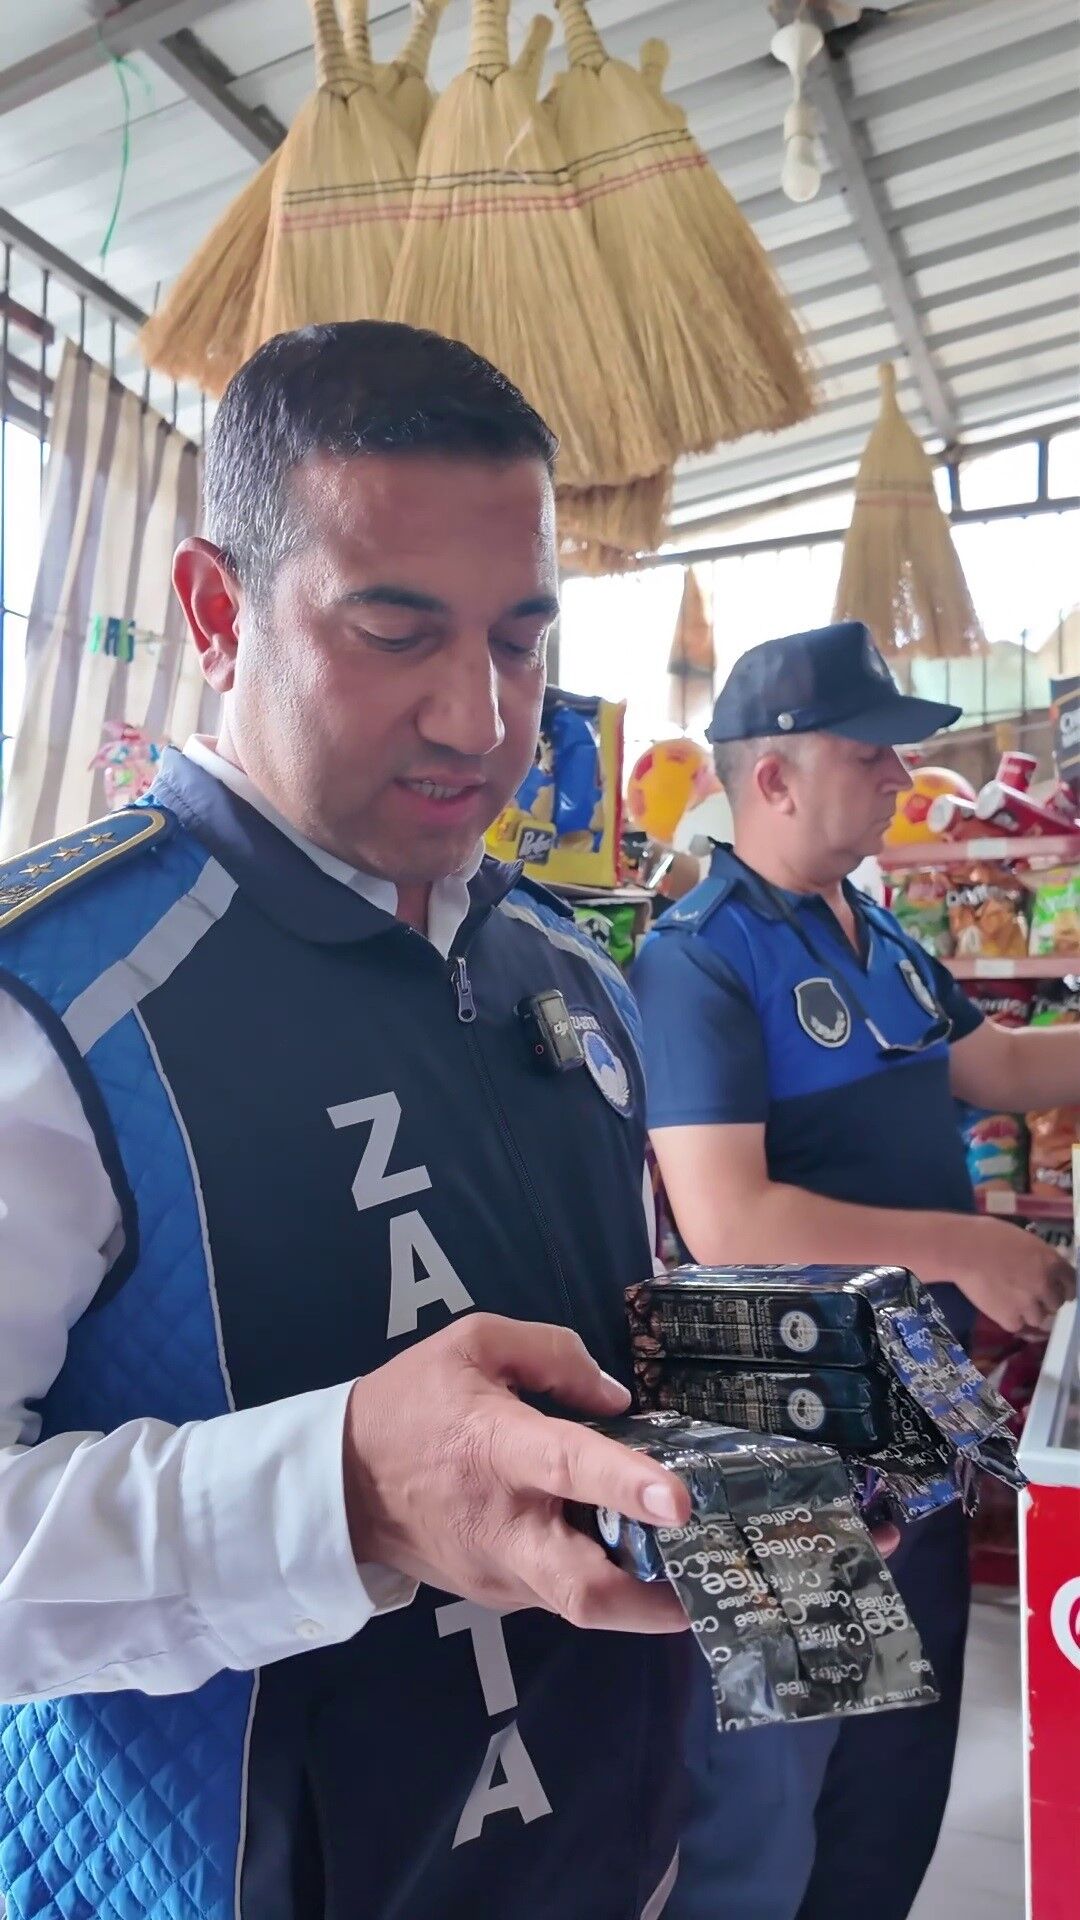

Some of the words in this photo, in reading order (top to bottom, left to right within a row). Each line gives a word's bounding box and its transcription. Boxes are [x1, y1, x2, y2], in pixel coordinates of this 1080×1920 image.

[747, 1506, 812, 1526] Coffee
[657, 1524, 724, 1543] Coffee
[752, 1532, 836, 1560] Coffee
[800, 1590, 850, 1609] Coffee
